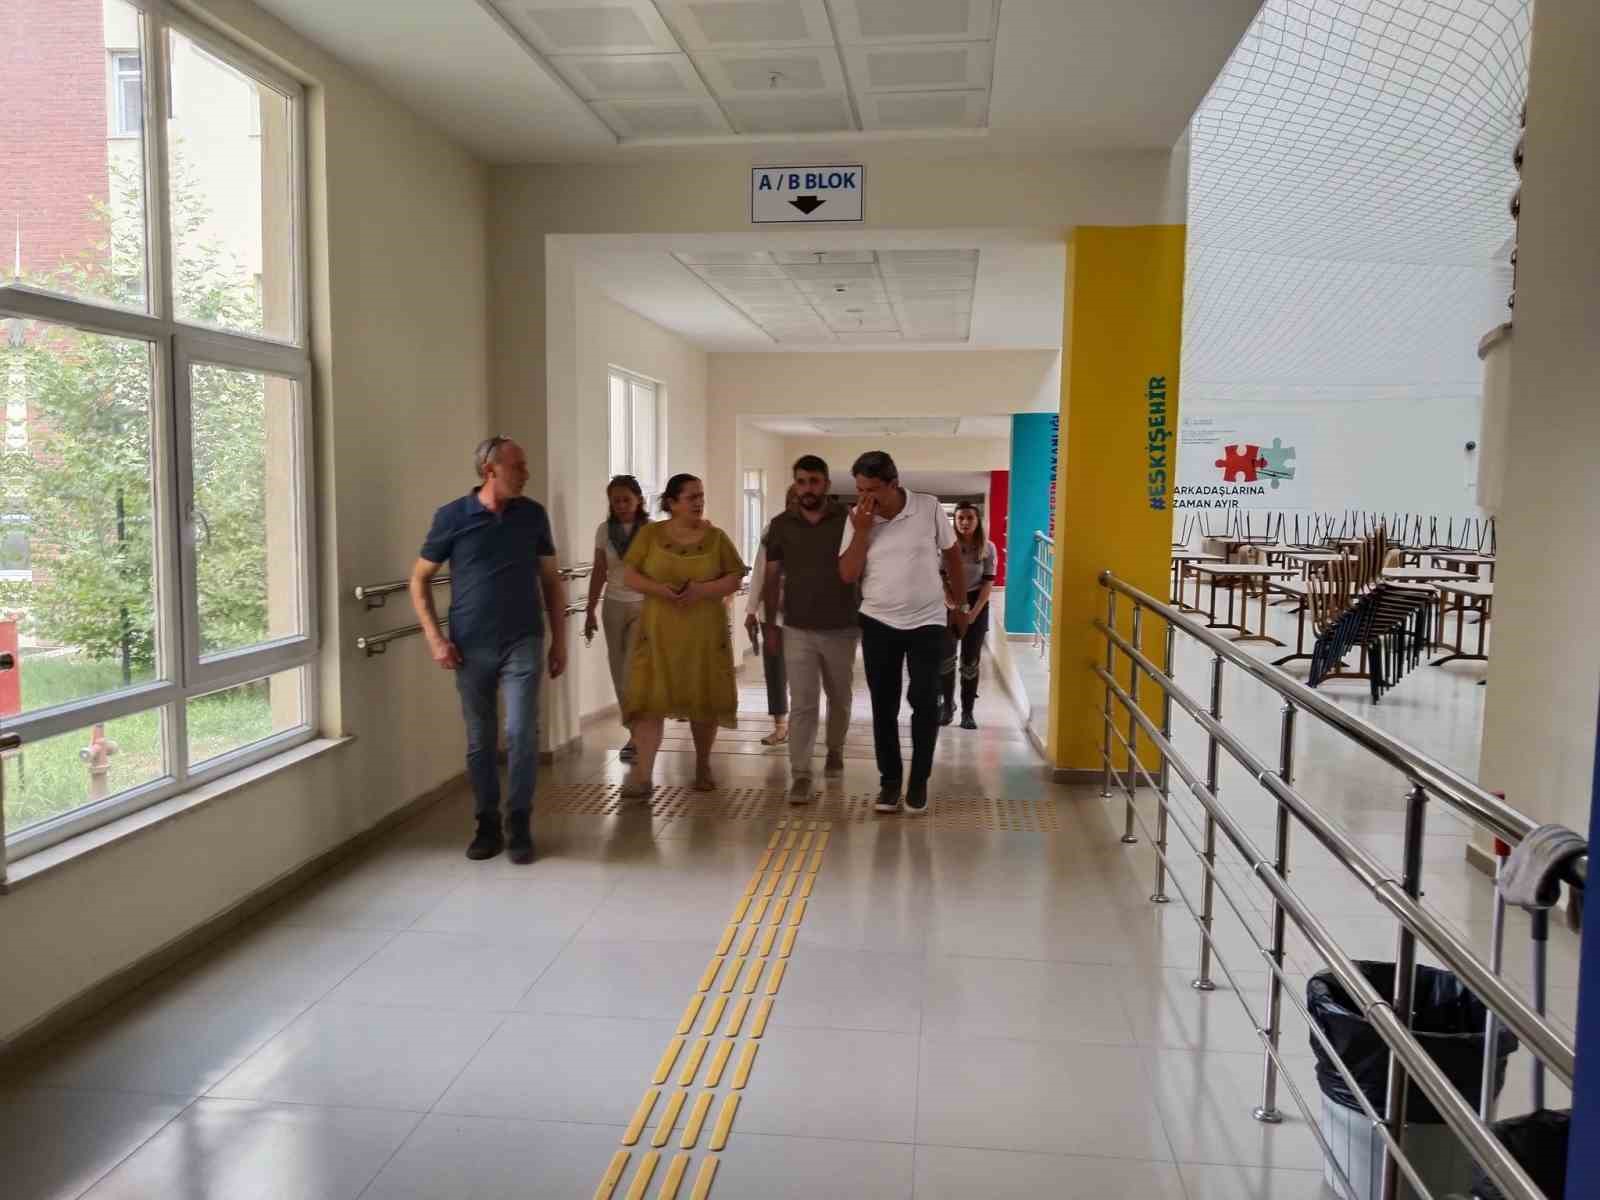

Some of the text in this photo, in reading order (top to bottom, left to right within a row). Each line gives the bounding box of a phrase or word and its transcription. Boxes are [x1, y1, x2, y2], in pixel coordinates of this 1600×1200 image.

[759, 174, 772, 190] A
[788, 174, 800, 190] B
[805, 172, 856, 190] BLOK
[1145, 376, 1172, 509] #ESKİŞEHİR
[1174, 486, 1265, 497] ARKADAŞLARINA
[1173, 500, 1239, 508] ZAMAN AYIR
